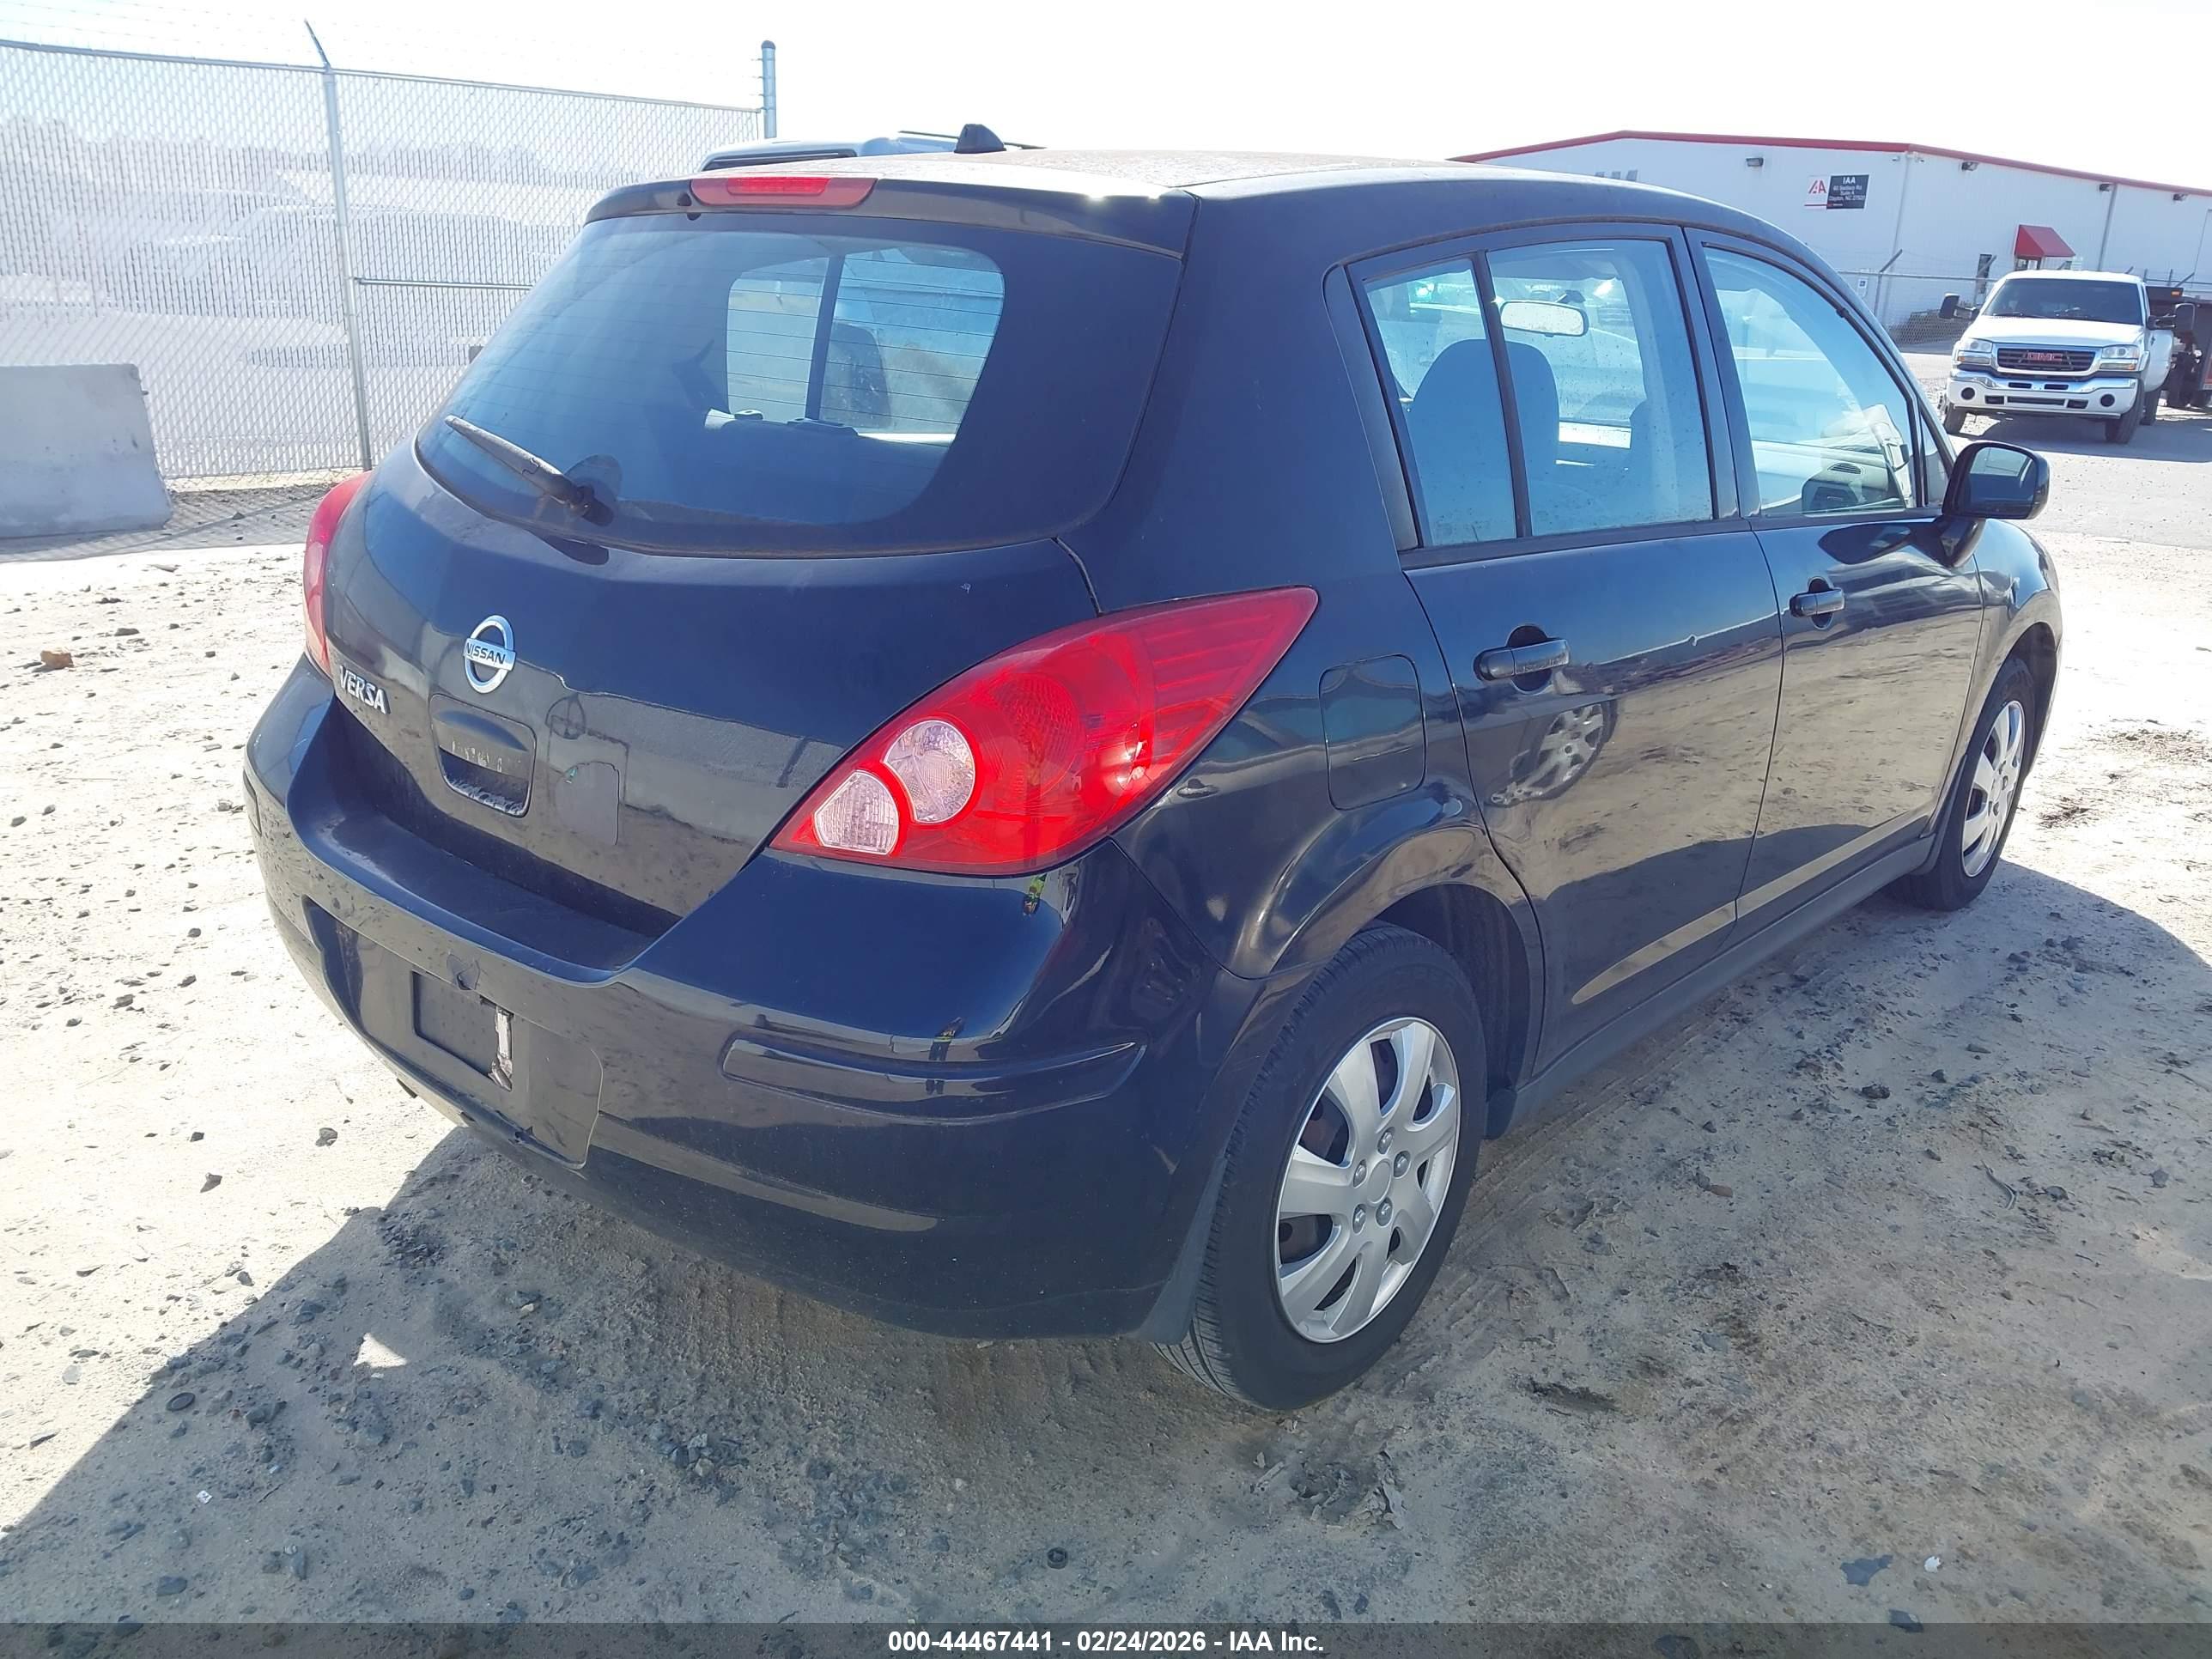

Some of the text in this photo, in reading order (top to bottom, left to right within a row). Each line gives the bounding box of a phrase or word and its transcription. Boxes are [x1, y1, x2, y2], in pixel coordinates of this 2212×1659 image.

[1842, 176, 1856, 185] IAA
[2027, 352, 2063, 362] GMC
[465, 641, 507, 665] NISSAN
[339, 665, 391, 714] VERSA
